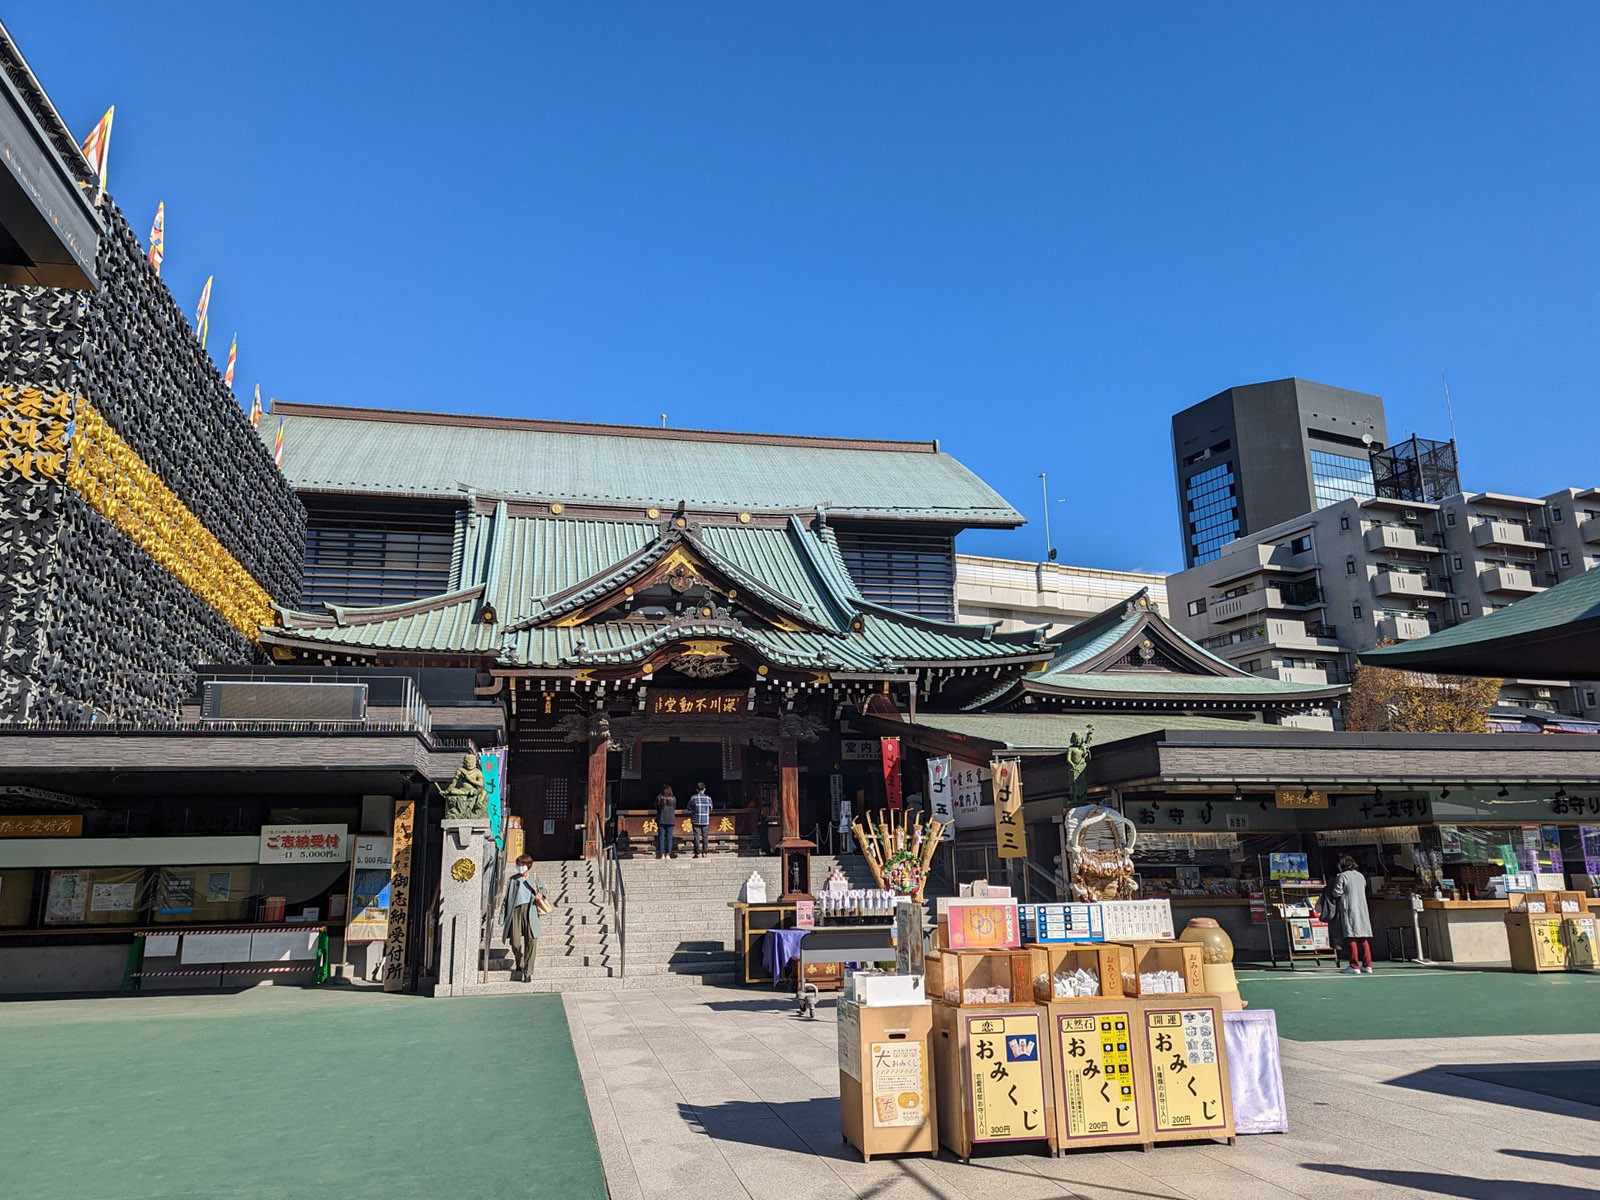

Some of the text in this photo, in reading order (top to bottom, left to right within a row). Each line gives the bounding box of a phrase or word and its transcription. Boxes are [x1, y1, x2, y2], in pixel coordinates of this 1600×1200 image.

[664, 696, 737, 713] 深川不動堂
[887, 755, 899, 804] 七五三
[933, 777, 952, 838] 七五三
[999, 784, 1019, 850] 七五三
[1140, 800, 1214, 825] お守り
[1359, 798, 1427, 820] 十二支守り
[266, 834, 340, 850] ご志納受付
[387, 873, 408, 980] 御志納受付所
[1538, 927, 1563, 964] おみくじ
[1106, 955, 1116, 990] おみくじ
[1189, 953, 1199, 987] おみくじ
[981, 1020, 994, 1033] 恋
[1064, 1018, 1093, 1031] 天然石
[1153, 1014, 1177, 1025] 開運
[875, 1049, 920, 1068] 犬 おみくじ
[975, 1039, 1039, 1131] おみくじ
[1068, 1037, 1131, 1127] おみくじ
[1155, 1032, 1217, 1120] おみくじ
[975, 1073, 986, 1135] 恋愛成就お守り入り
[990, 1125, 1011, 1134] 300円
[1088, 1121, 1109, 1130] 200円
[1171, 1114, 1192, 1124] 200円
